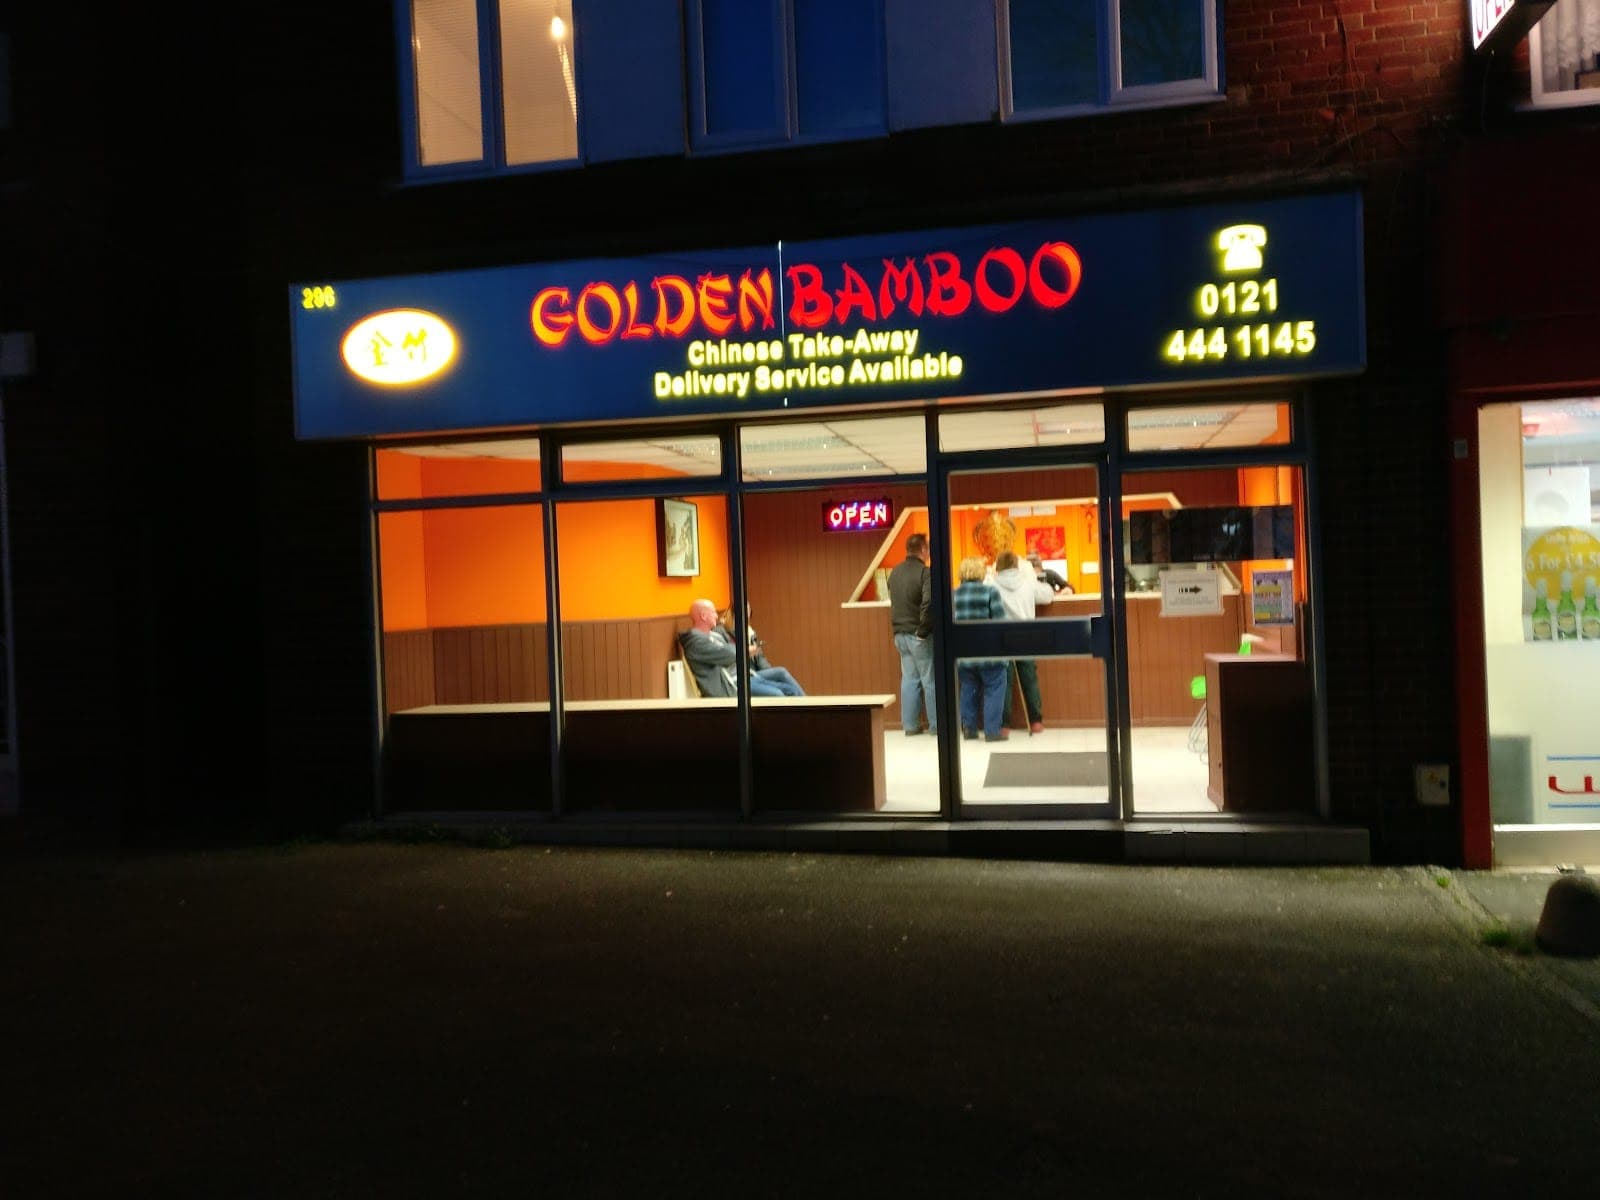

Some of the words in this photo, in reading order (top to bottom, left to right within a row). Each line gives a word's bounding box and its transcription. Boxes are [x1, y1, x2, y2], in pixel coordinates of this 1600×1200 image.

[531, 267, 775, 347] GOLDEN
[786, 241, 1082, 329] BAMBOO
[1198, 278, 1278, 317] 0121
[687, 338, 784, 367] Chinese
[788, 328, 920, 359] Take-Away
[1165, 326, 1229, 362] 444
[1234, 319, 1317, 358] 1145
[654, 370, 751, 397] Delivery
[753, 361, 846, 391] Service
[848, 350, 964, 384] Available
[829, 503, 888, 527] OPEN
